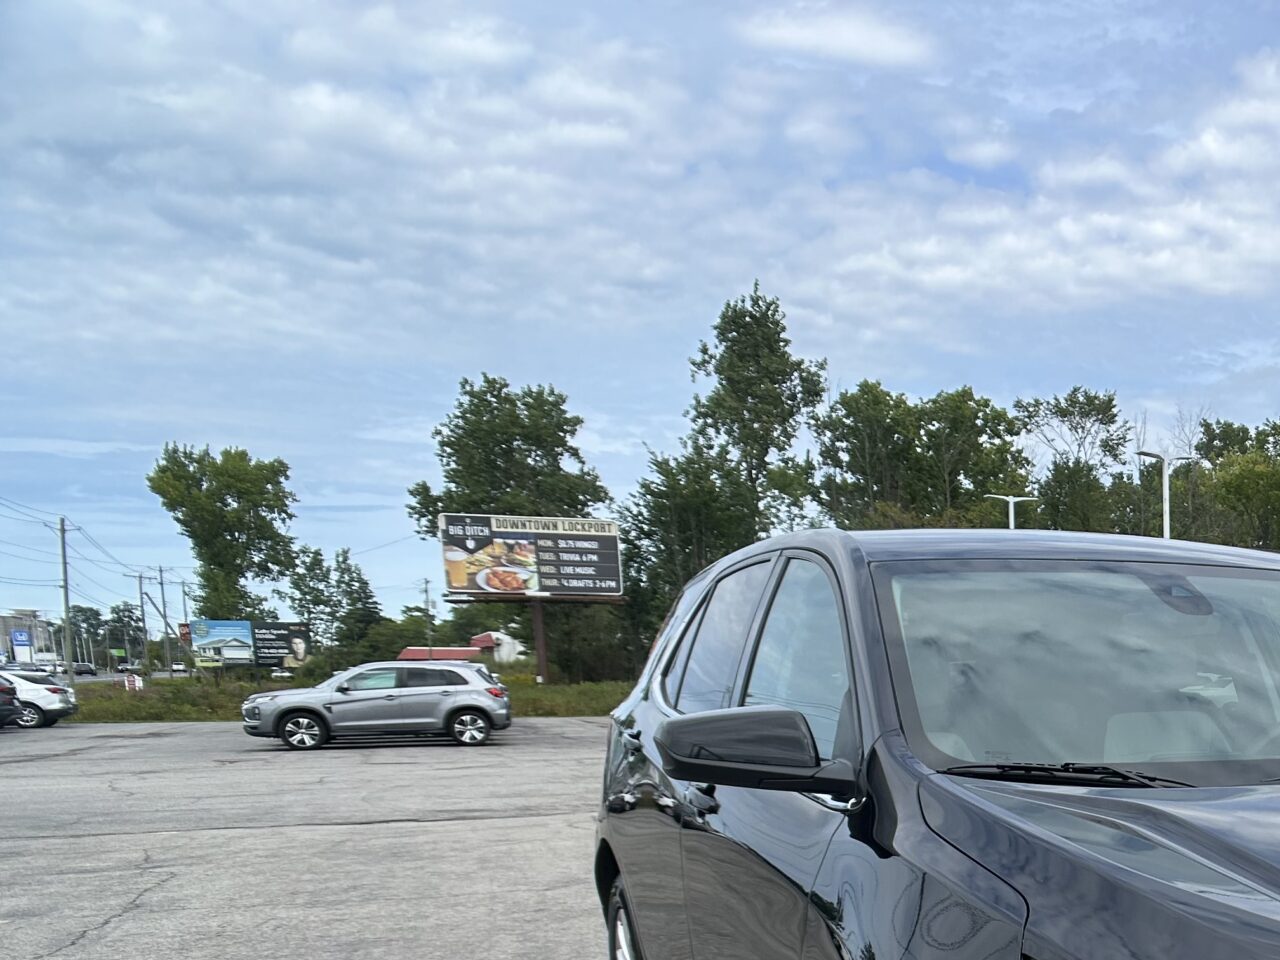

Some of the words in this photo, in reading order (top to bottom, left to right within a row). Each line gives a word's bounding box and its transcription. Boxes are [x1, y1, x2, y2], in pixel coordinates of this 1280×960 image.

[496, 518, 558, 531] DOWNTOWN
[562, 521, 612, 533] LOCKPORT
[448, 525, 464, 535] BIG
[465, 526, 490, 536] DITCH
[559, 552, 580, 561] TRIVIA
[561, 566, 574, 574] LIVE
[575, 566, 597, 574] MUSIC
[569, 579, 593, 587] DRAFTS
